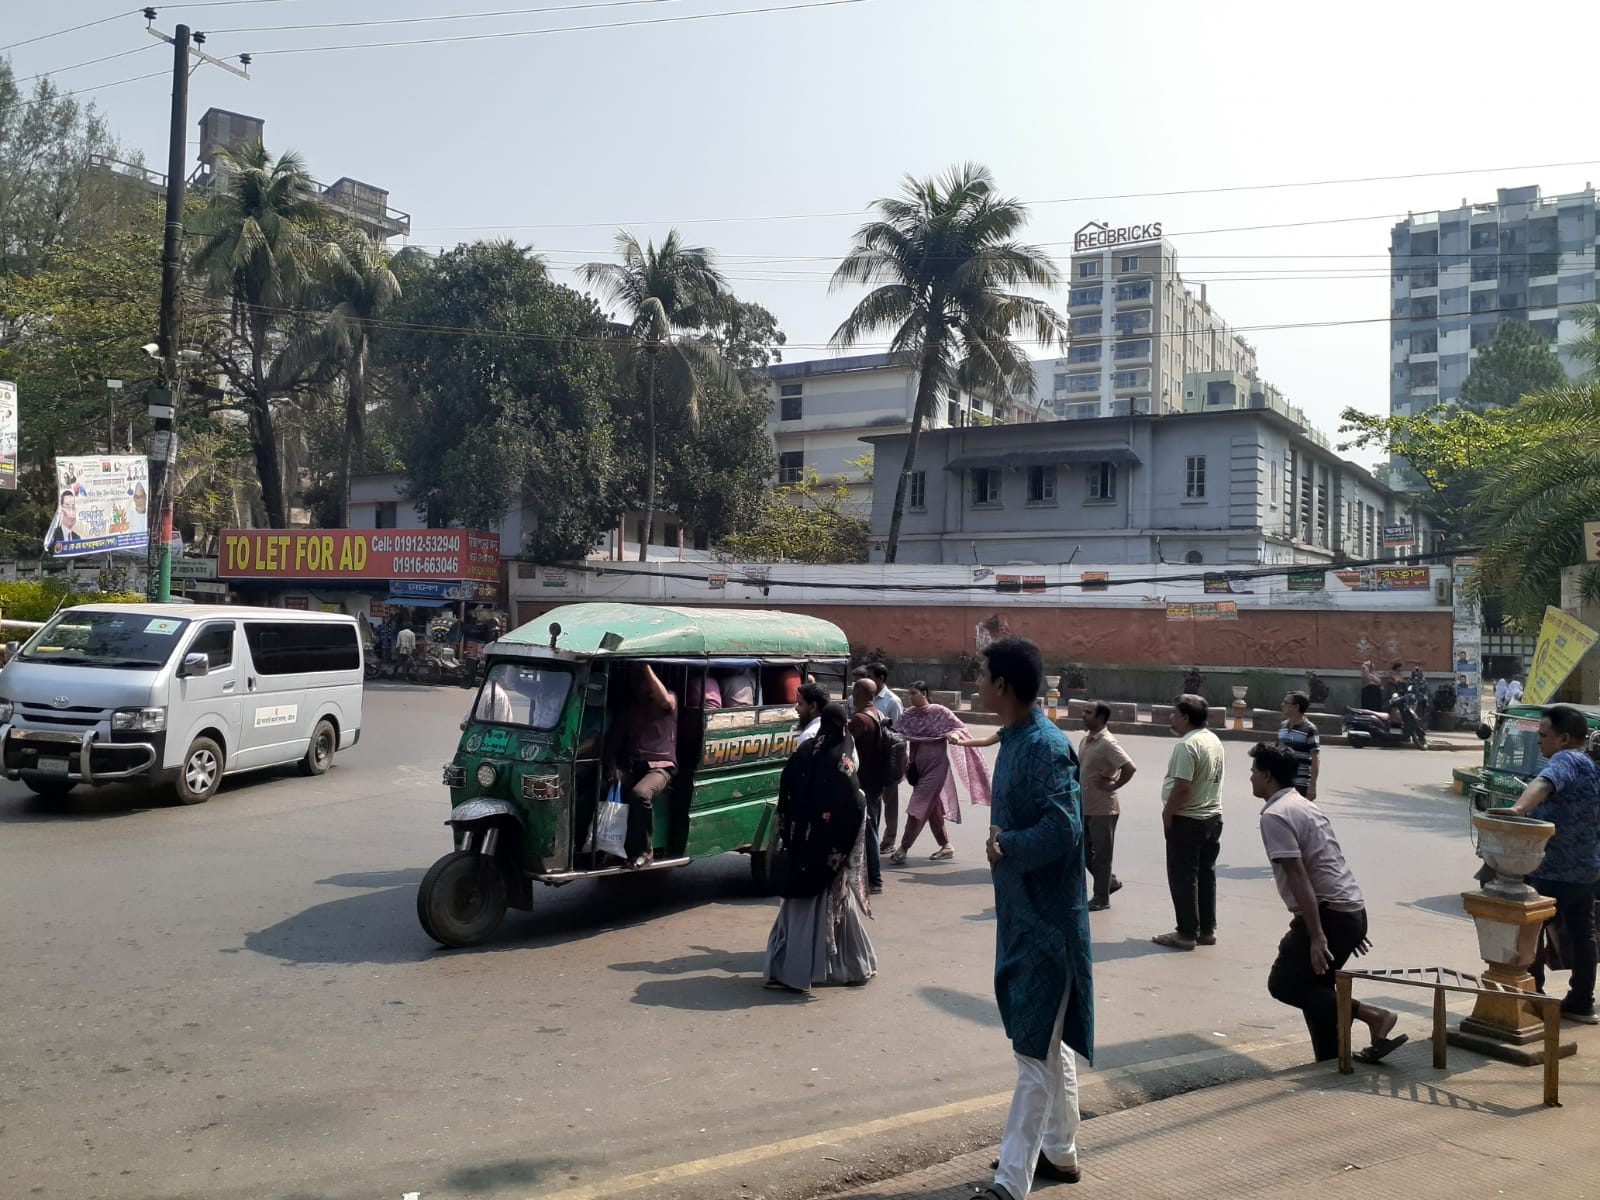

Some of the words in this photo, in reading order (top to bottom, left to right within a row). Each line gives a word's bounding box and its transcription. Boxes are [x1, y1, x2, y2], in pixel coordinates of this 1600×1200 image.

[1078, 222, 1163, 249] REDBRICKS
[226, 535, 250, 570] TO
[255, 535, 291, 570] LET
[295, 535, 334, 571] FOR
[339, 535, 367, 571] AD
[371, 535, 392, 552] Cell:
[394, 535, 460, 552] 01912-532940
[393, 556, 459, 573] 01916-663046
